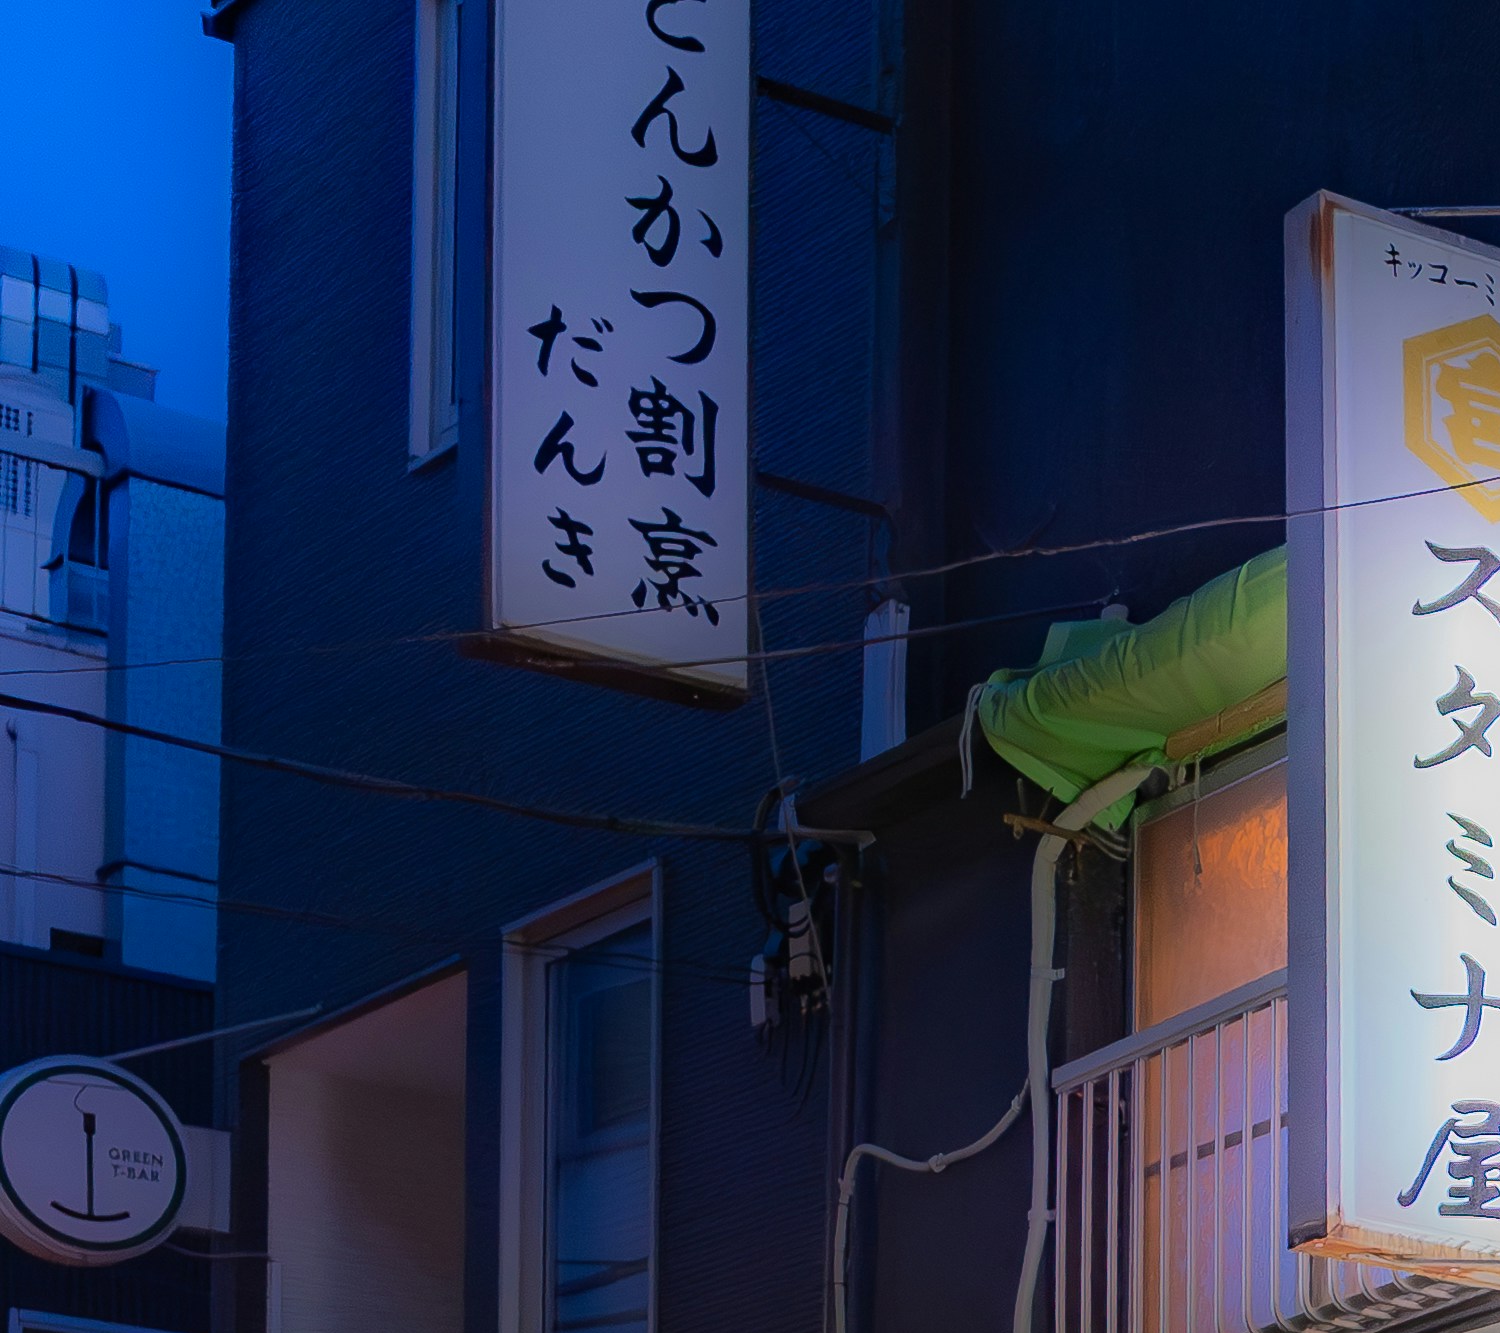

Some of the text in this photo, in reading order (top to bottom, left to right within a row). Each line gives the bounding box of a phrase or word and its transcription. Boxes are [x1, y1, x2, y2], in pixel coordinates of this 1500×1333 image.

[526, 303, 615, 588] だんき
[108, 1147, 163, 1167] GREEN
[112, 1164, 161, 1182] T-BAR
